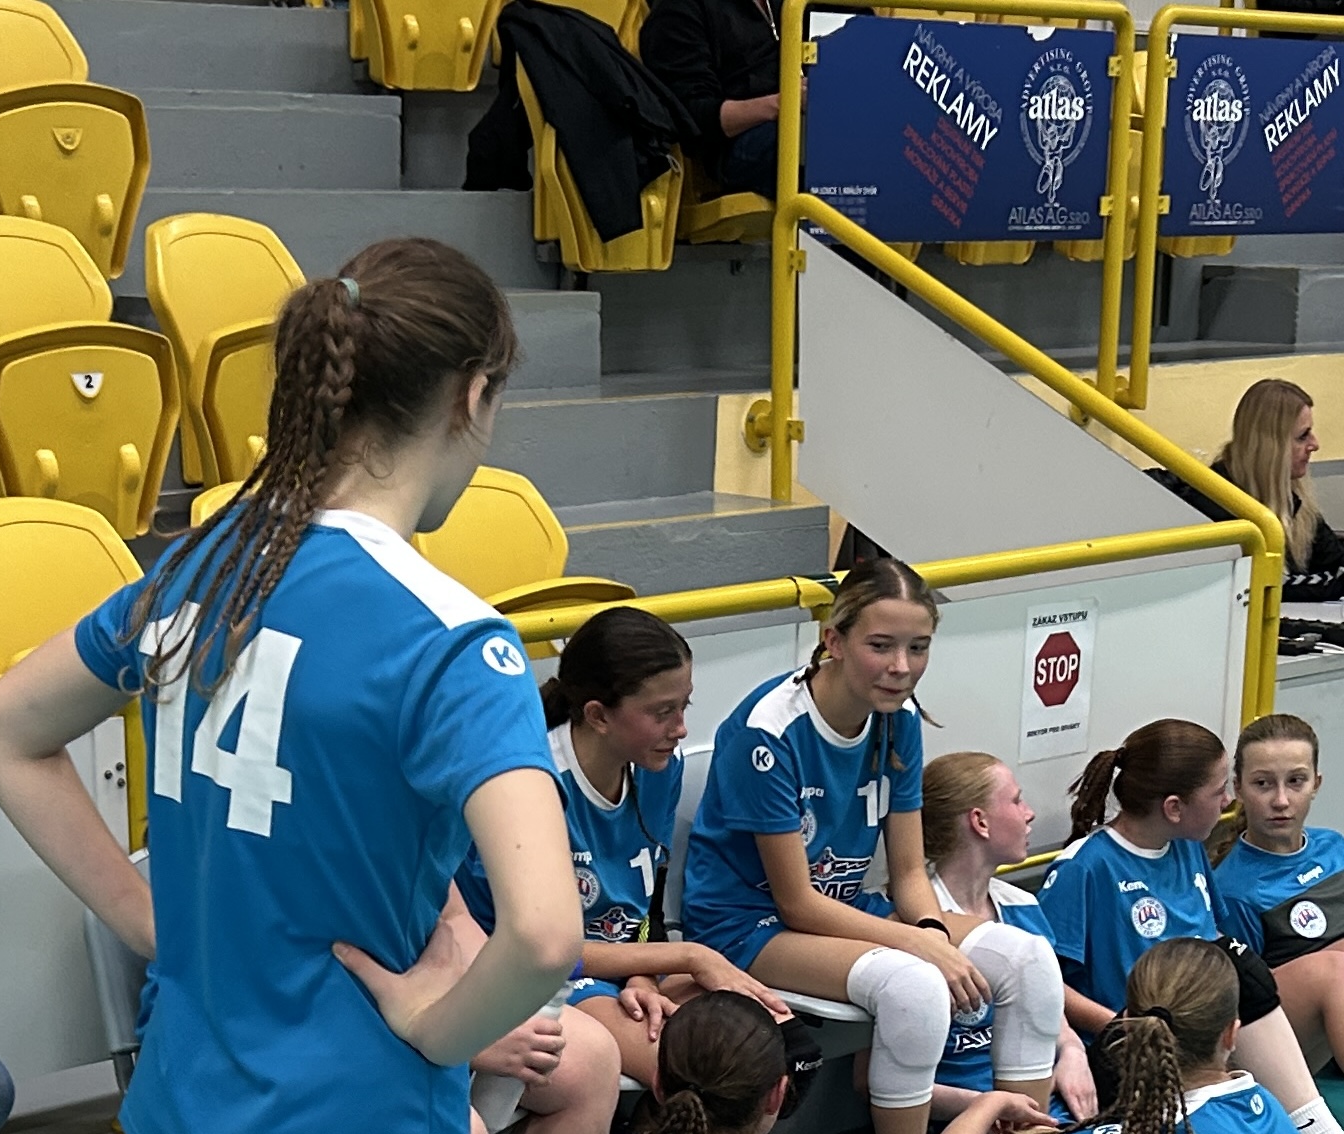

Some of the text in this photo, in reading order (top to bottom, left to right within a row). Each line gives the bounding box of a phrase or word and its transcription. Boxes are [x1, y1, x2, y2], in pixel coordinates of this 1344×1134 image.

[903, 42, 998, 150] REKLAMY
[1028, 87, 1086, 121] atlas
[1192, 92, 1244, 122] atlas
[1263, 58, 1341, 152] REKLAMY
[1008, 207, 1045, 225] ATLAS
[1189, 203, 1223, 221] ATLAS
[84, 374, 95, 389] 2
[1032, 610, 1088, 627] ZÁKAZ VSTUPU
[1036, 653, 1079, 686] STOP
[139, 602, 302, 837] 14
[1296, 865, 1324, 886] Kempa
